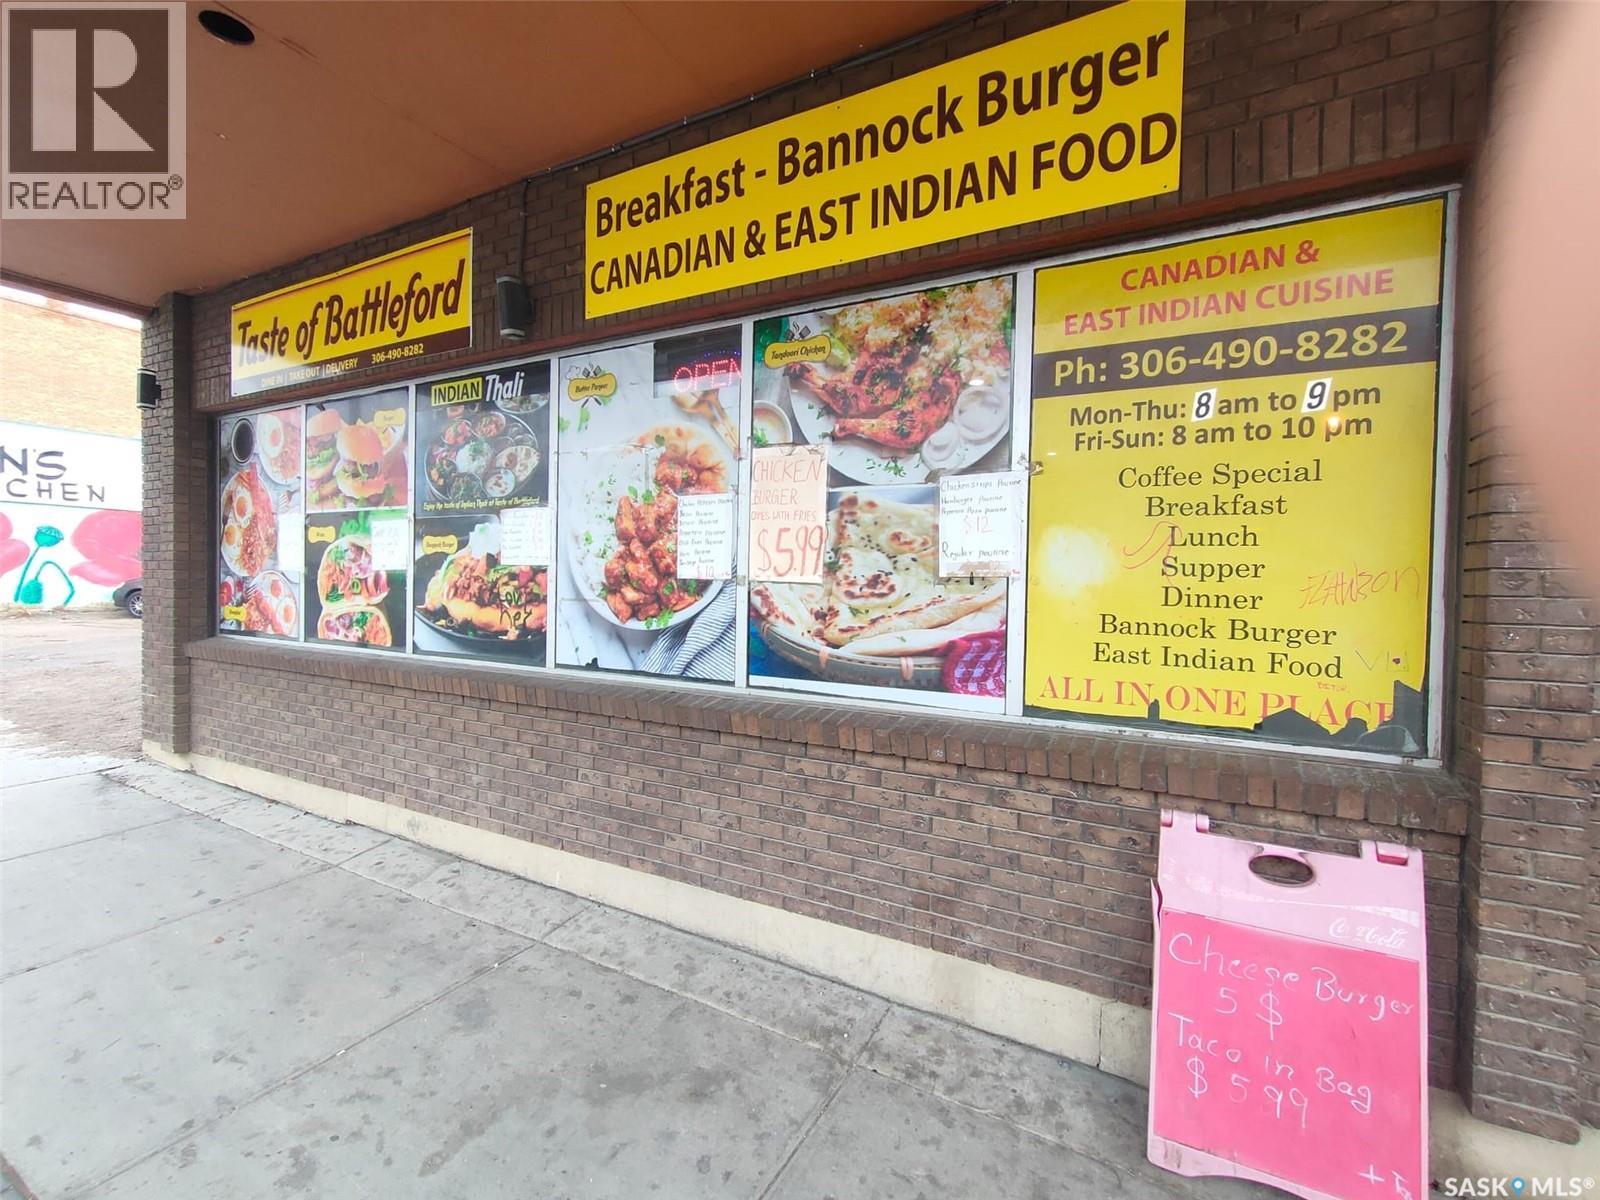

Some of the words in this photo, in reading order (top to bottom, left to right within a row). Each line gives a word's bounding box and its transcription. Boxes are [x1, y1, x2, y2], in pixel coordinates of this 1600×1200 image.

[596, 159, 745, 236] Breakfast
[777, 86, 963, 185] Bannock
[978, 30, 1170, 126] Burger
[591, 226, 735, 295] CANADIAN
[744, 221, 766, 258] &
[775, 194, 860, 251] EAST
[871, 151, 1017, 228] INDIAN
[1032, 112, 1178, 190] FOOD
[1120, 245, 1286, 291] CANADIAN
[1295, 239, 1321, 263] &
[238, 316, 290, 367] Taste
[295, 301, 323, 361] of
[323, 258, 466, 347] Battleford
[1064, 306, 1132, 336] EAST
[1138, 290, 1246, 326] INDIAN
[1255, 268, 1395, 309] CUISINE
[289, 368, 305, 380] TAKE
[305, 366, 321, 378] OUT
[326, 357, 358, 375] DELIVERY
[371, 343, 424, 364] 306-490-8282
[771, 348, 799, 360] Tandoori
[800, 345, 826, 356] Chicken
[1055, 357, 1108, 387] Ph:
[1119, 321, 1408, 381] 306-490-8282
[433, 381, 480, 404] INDIAN
[485, 371, 525, 401] Thali
[673, 357, 742, 393] OPEN
[1070, 400, 1187, 427] Mon-Thu:
[1195, 393, 1212, 419] 8
[1218, 399, 1259, 415] am
[1268, 393, 1297, 411] to
[1308, 381, 1328, 409] 9
[1332, 385, 1381, 412] pm
[1074, 429, 1164, 452] Fri-Sun:
[1172, 425, 1187, 445] 8
[1195, 429, 1234, 444] am
[1243, 421, 1272, 441] to
[1281, 416, 1315, 440] 10
[1324, 415, 1373, 442] pm
[752, 459, 821, 482] CHICKEN
[1118, 465, 1202, 489] Coffee
[1213, 459, 1322, 489] Special
[6, 478, 105, 502] CHEN
[1145, 494, 1288, 518] Breakfast
[773, 510, 790, 521] WITH
[793, 510, 816, 521] FRIES
[757, 524, 824, 578] $5.99
[942, 541, 972, 561] Regular
[1168, 524, 1259, 547] Lunch
[1161, 555, 1265, 582] Supper
[1161, 585, 1264, 610] Dinner
[1099, 613, 1217, 640] Bannock
[1228, 618, 1337, 649] Burger
[1093, 643, 1151, 666] East
[1161, 645, 1256, 673] Indian
[1267, 652, 1343, 679] Food
[1039, 675, 1104, 703] ALL
[1115, 680, 1155, 707] IN
[1165, 685, 1247, 717] ONE
[1329, 917, 1408, 949] Coa-Cola
[1168, 933, 1299, 988] Cheese
[1310, 967, 1414, 1022] Burger
[1216, 987, 1238, 1015] 5
[1256, 987, 1283, 1041] $
[1167, 1011, 1242, 1064] Taco
[1265, 1056, 1294, 1079] in
[1315, 1067, 1373, 1114] Bag
[1187, 1055, 1208, 1098] $
